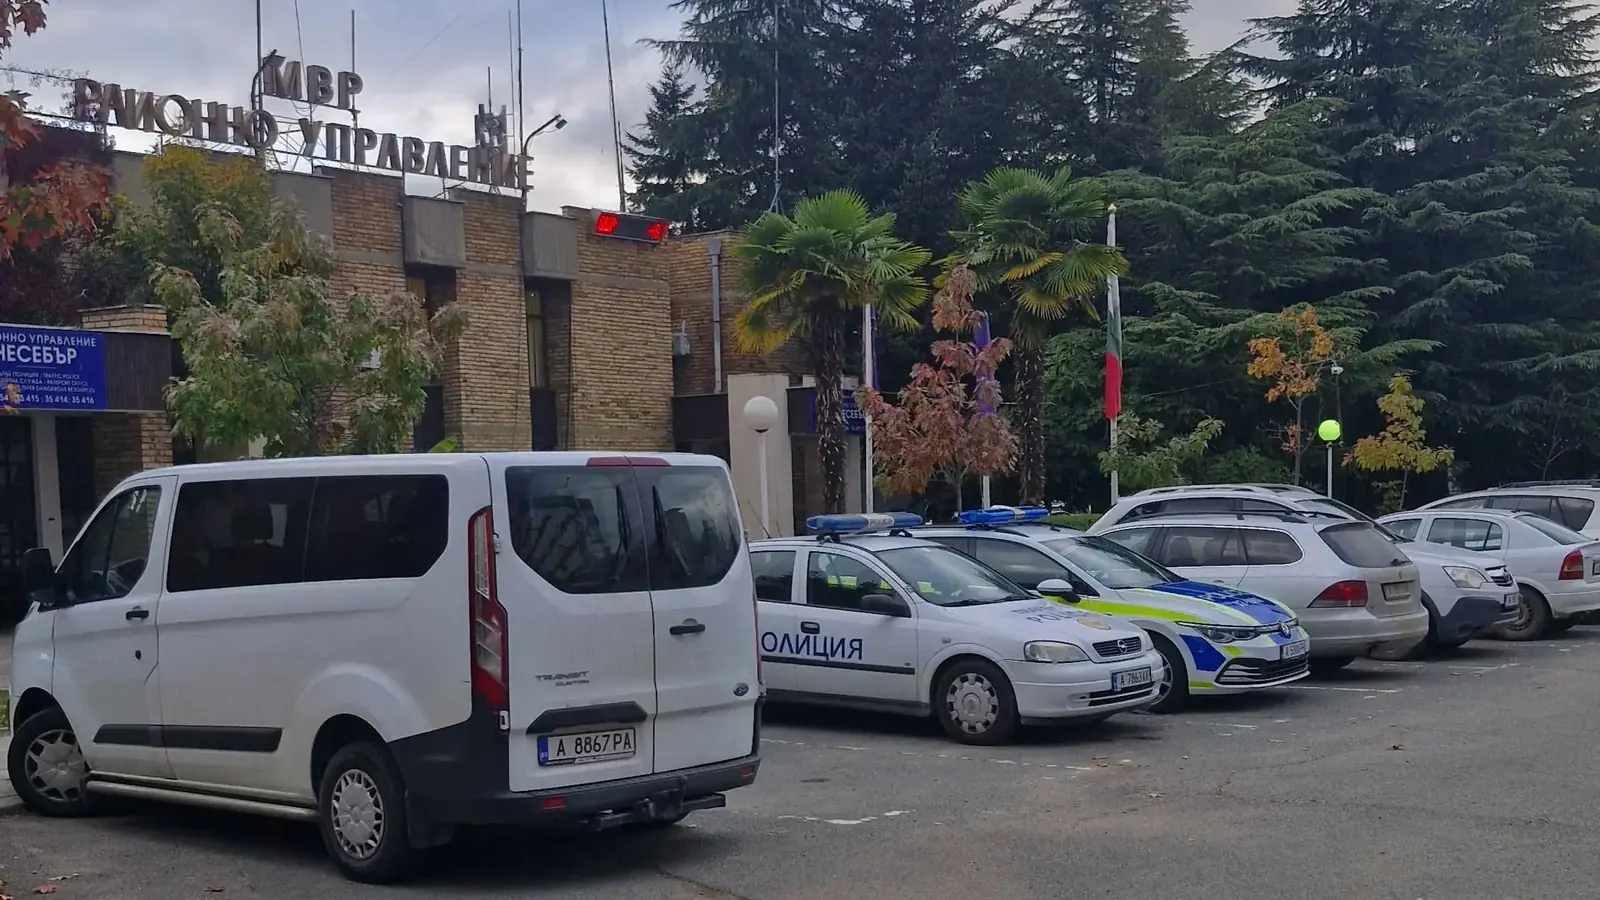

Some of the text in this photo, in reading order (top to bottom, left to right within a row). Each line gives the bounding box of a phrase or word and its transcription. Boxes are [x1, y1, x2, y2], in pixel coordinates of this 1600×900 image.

[263, 55, 363, 110] МВР
[298, 118, 534, 190] УПРАВЛЕНИЕ
[0, 332, 97, 347] ННО УПРАВЛЕНИЕ
[761, 631, 863, 661] ОЛИЦИЯ
[535, 670, 590, 681] TRANSIT
[557, 738, 566, 757] A
